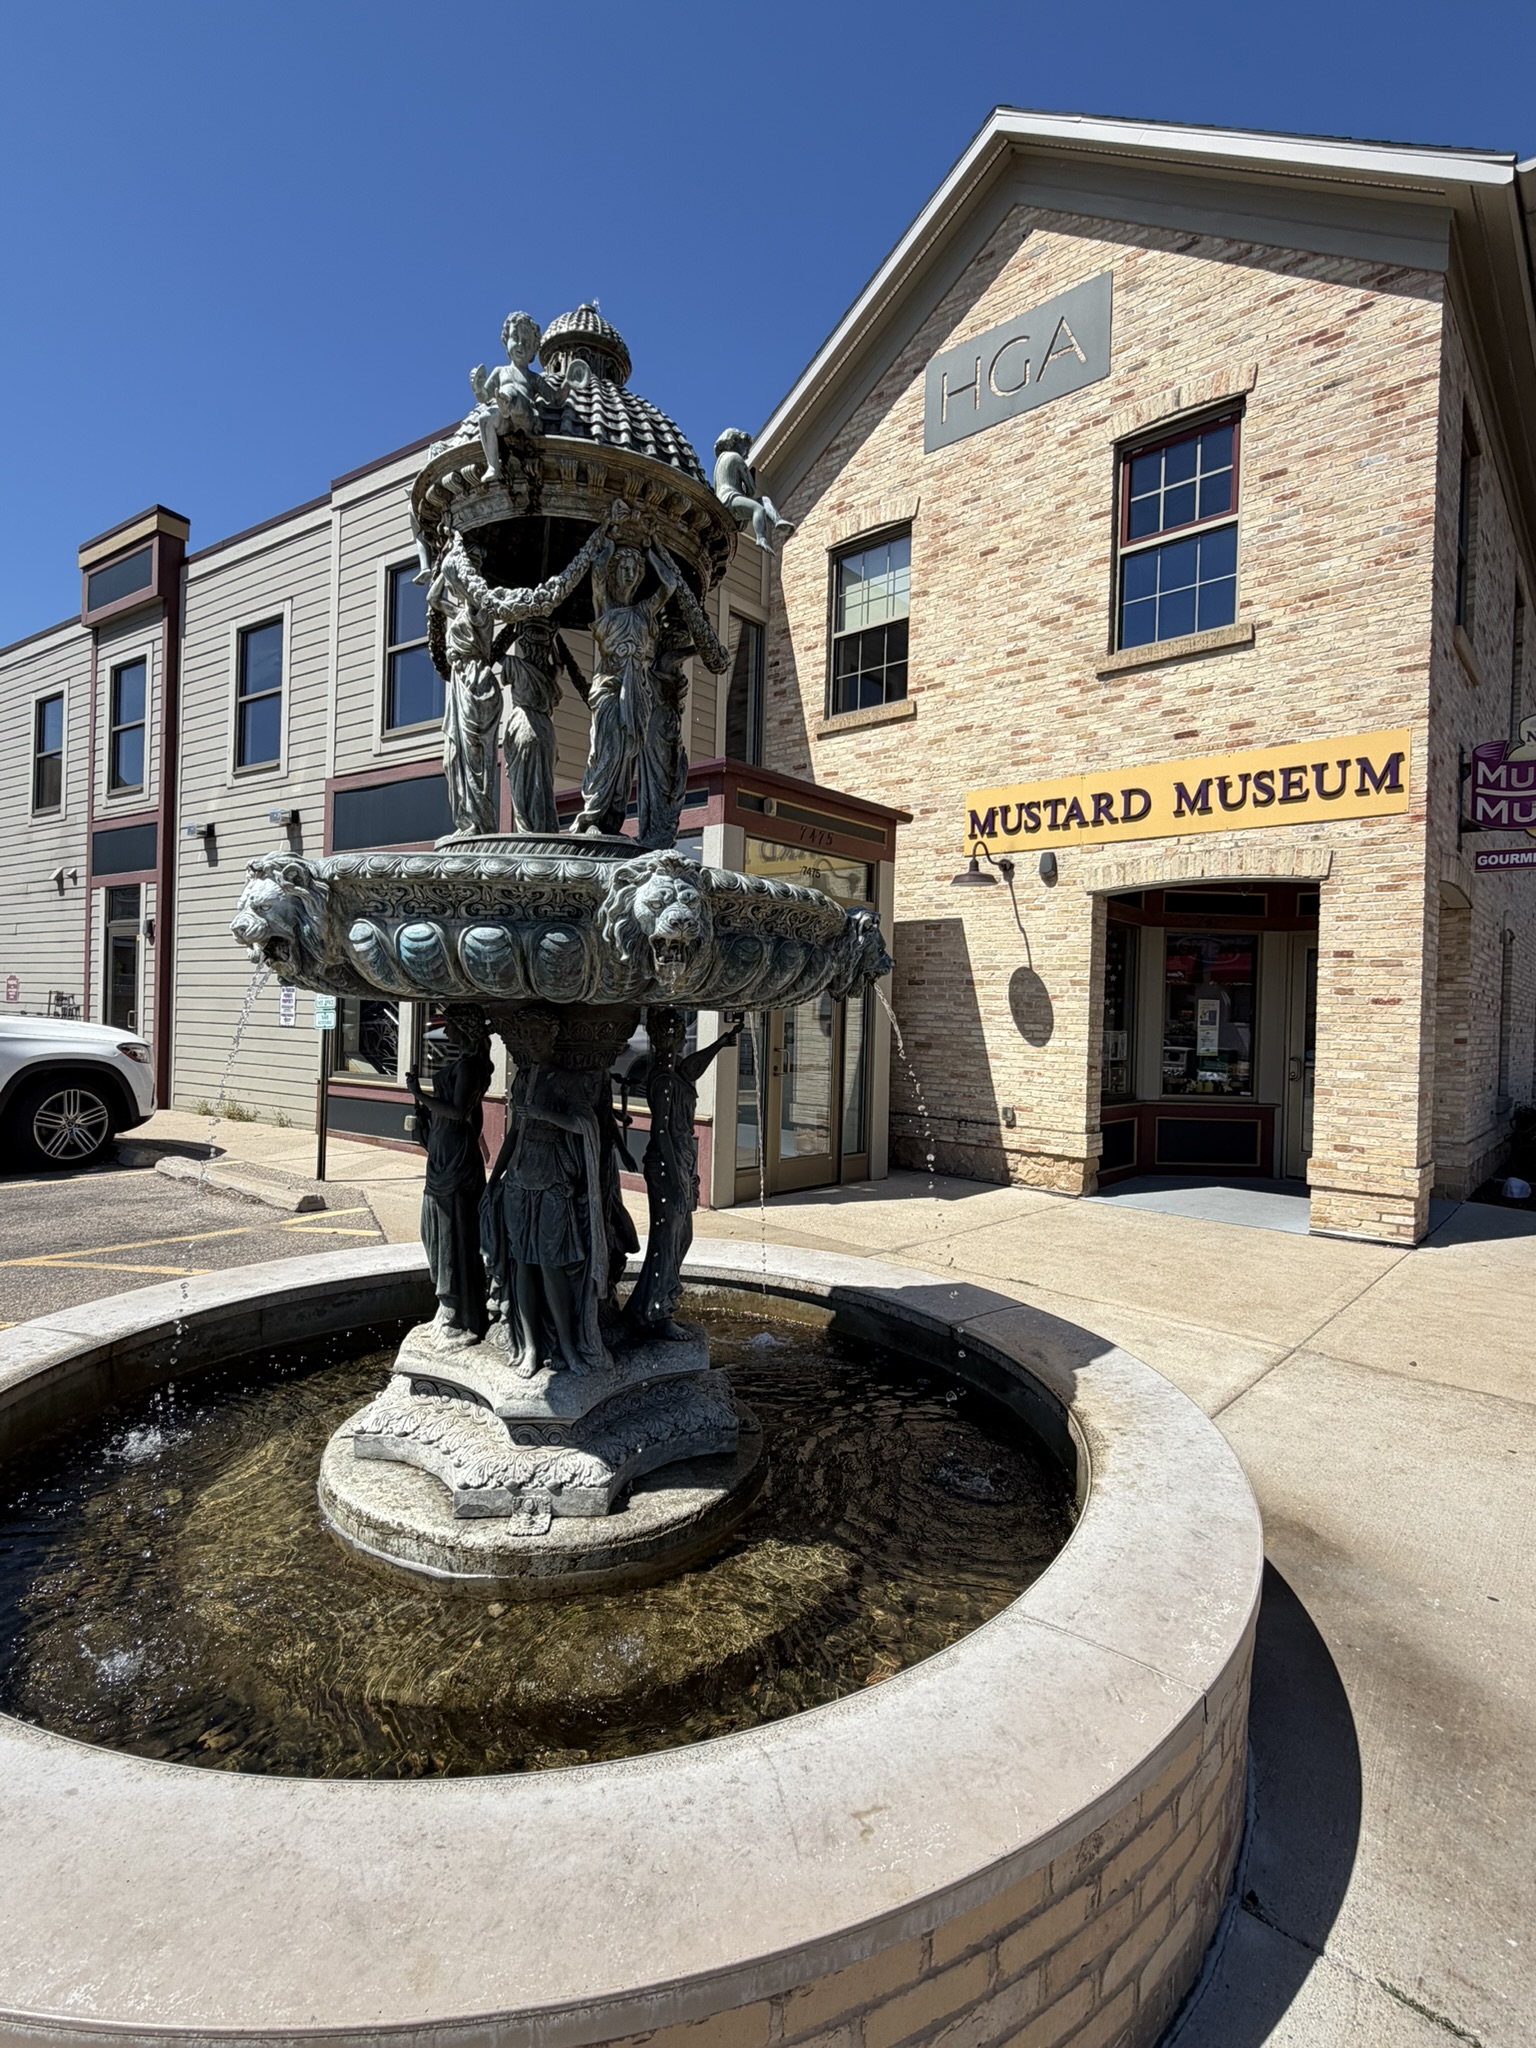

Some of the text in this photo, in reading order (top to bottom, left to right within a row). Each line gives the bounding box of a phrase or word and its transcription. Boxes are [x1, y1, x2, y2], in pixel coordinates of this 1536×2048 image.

[941, 315, 1087, 425] HGA
[1477, 761, 1535, 788] MU
[967, 752, 1406, 840] MUSTARD MUSEUM
[800, 825, 833, 846] 7475
[802, 865, 821, 879] 7475
